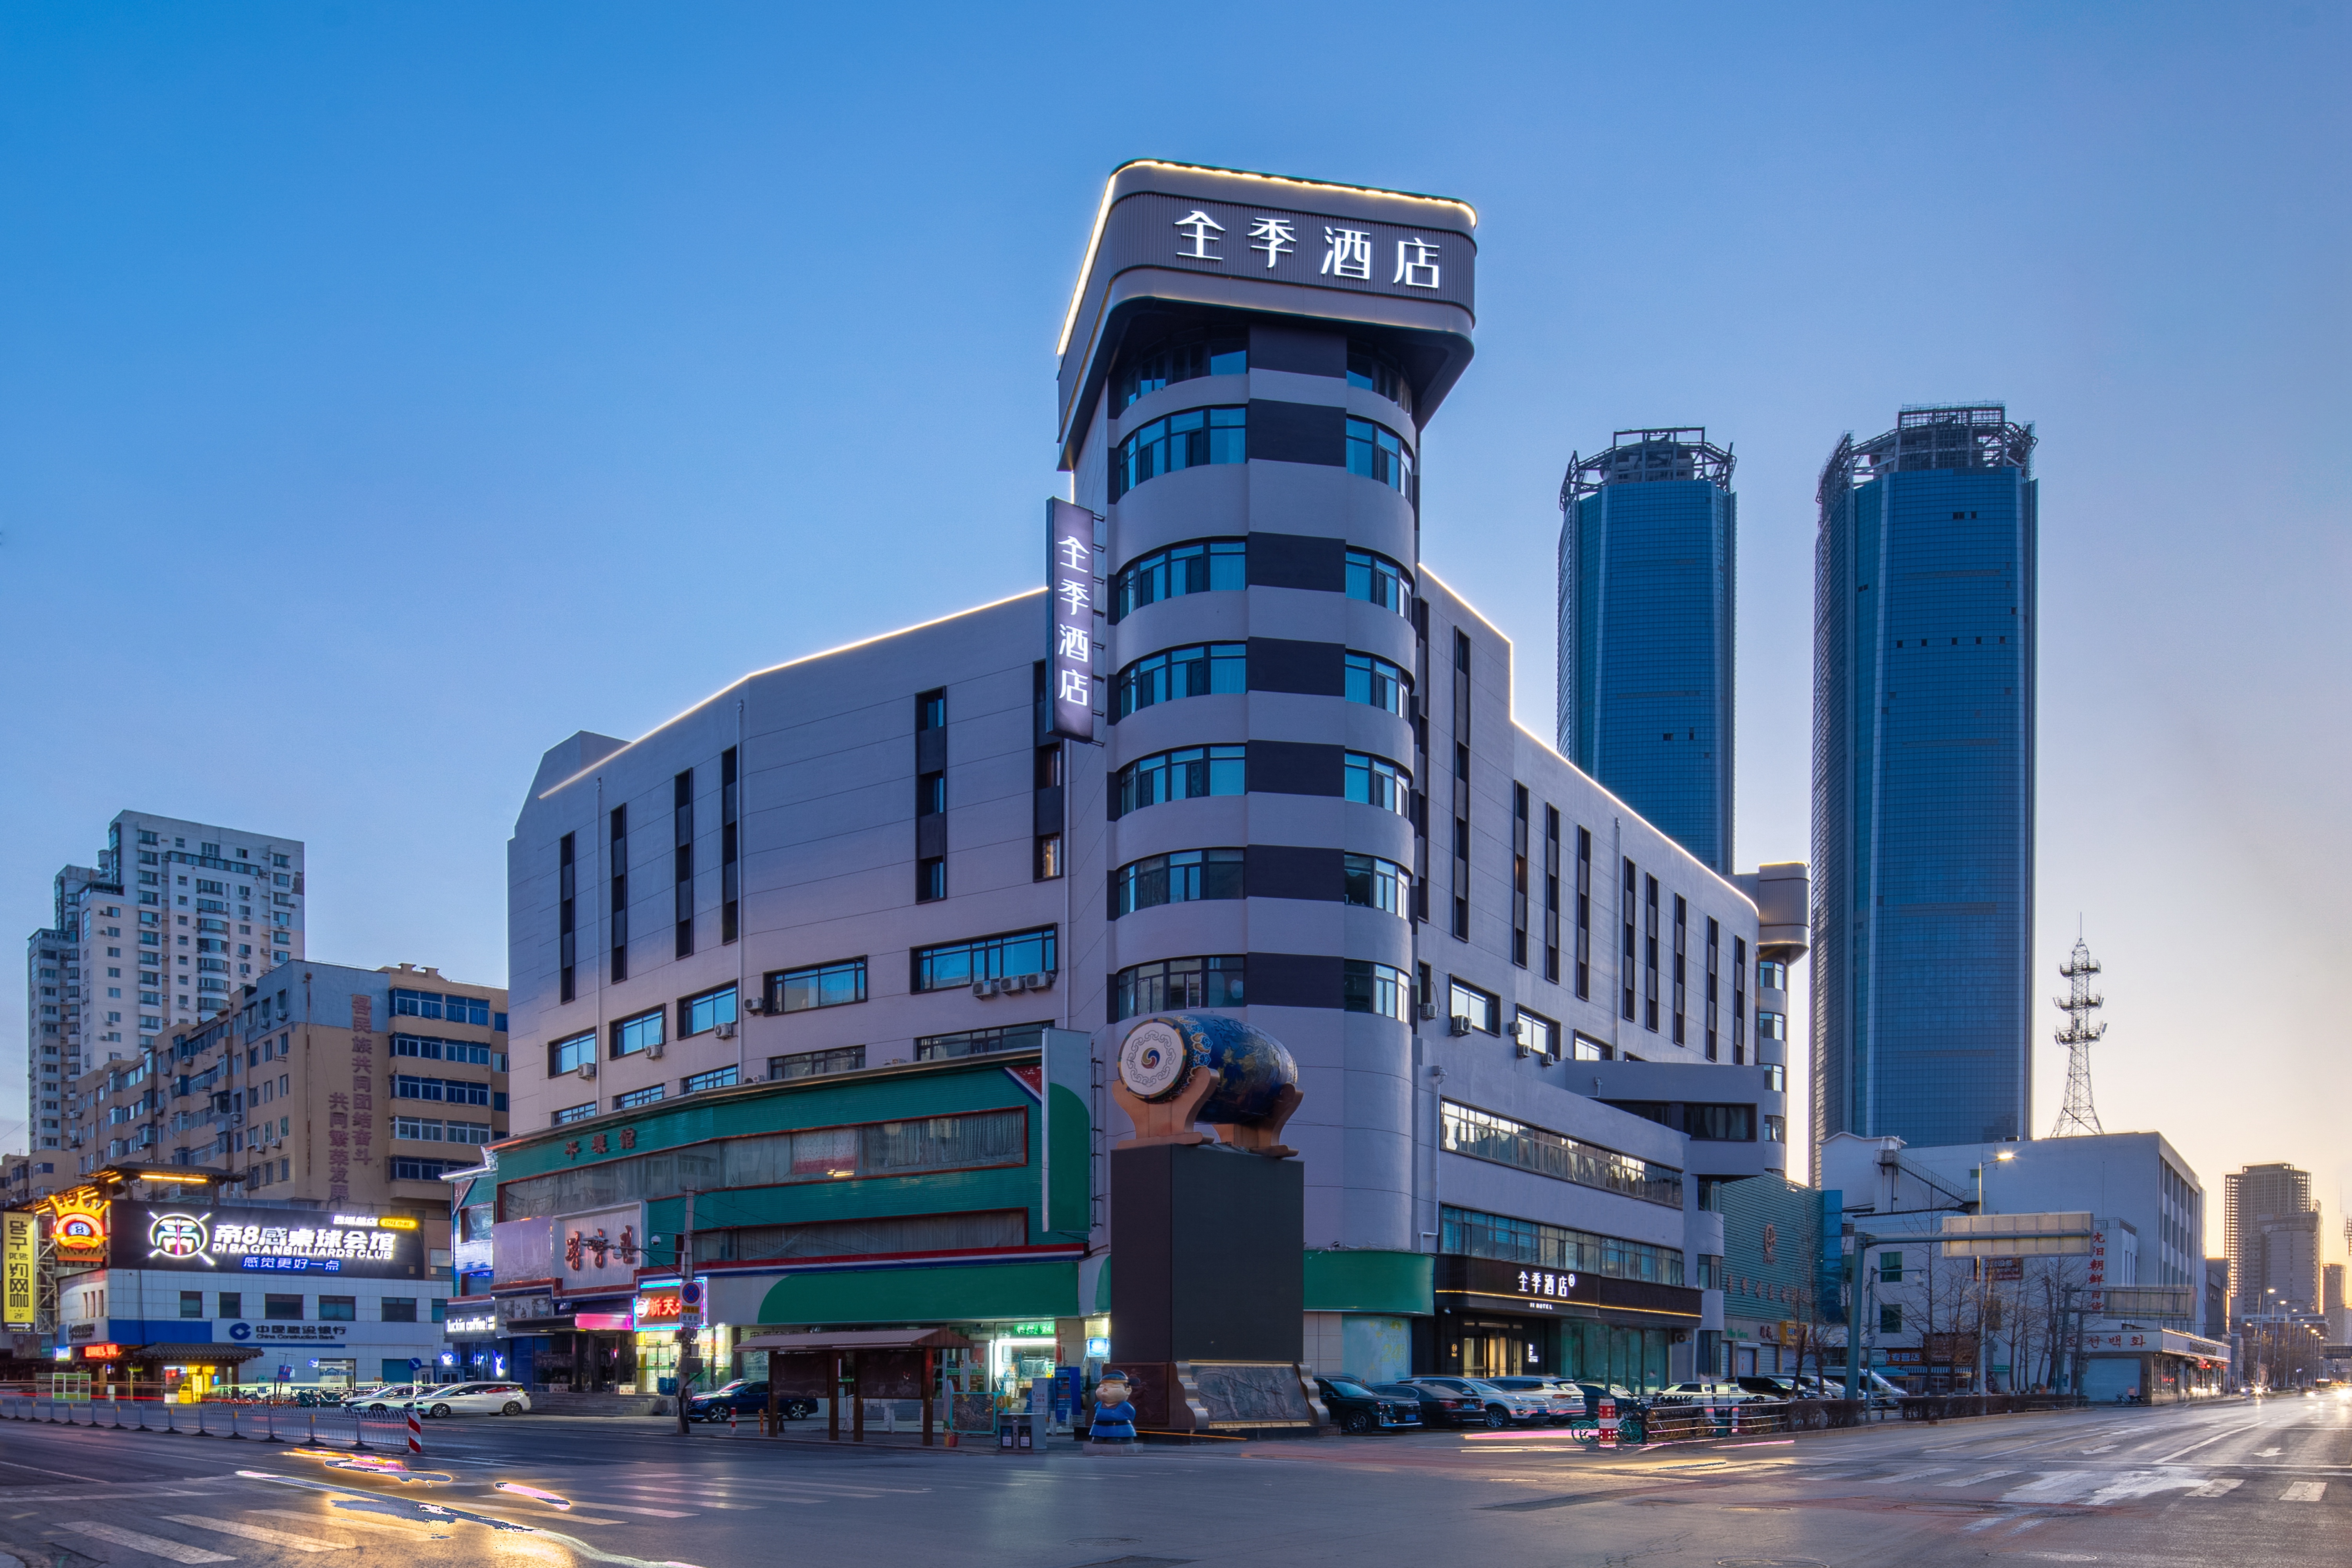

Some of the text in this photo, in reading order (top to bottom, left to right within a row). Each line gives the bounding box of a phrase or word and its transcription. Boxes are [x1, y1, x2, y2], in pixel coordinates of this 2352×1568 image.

[1174, 210, 1440, 289] 全季酒店
[1058, 536, 1090, 706] 全季酒店
[352, 996, 372, 1165] 各民族共同团结奋斗
[9, 1220, 28, 1250] 당구
[214, 1224, 396, 1251] 帝8感桌球会馆
[243, 1257, 339, 1270] 感觉更好一点
[356, 1249, 393, 1260] CLUB
[1518, 1271, 1567, 1297] 全季酒店
[256, 1325, 346, 1334] 中国建设银行
[1380, 1343, 1401, 1363] 24
